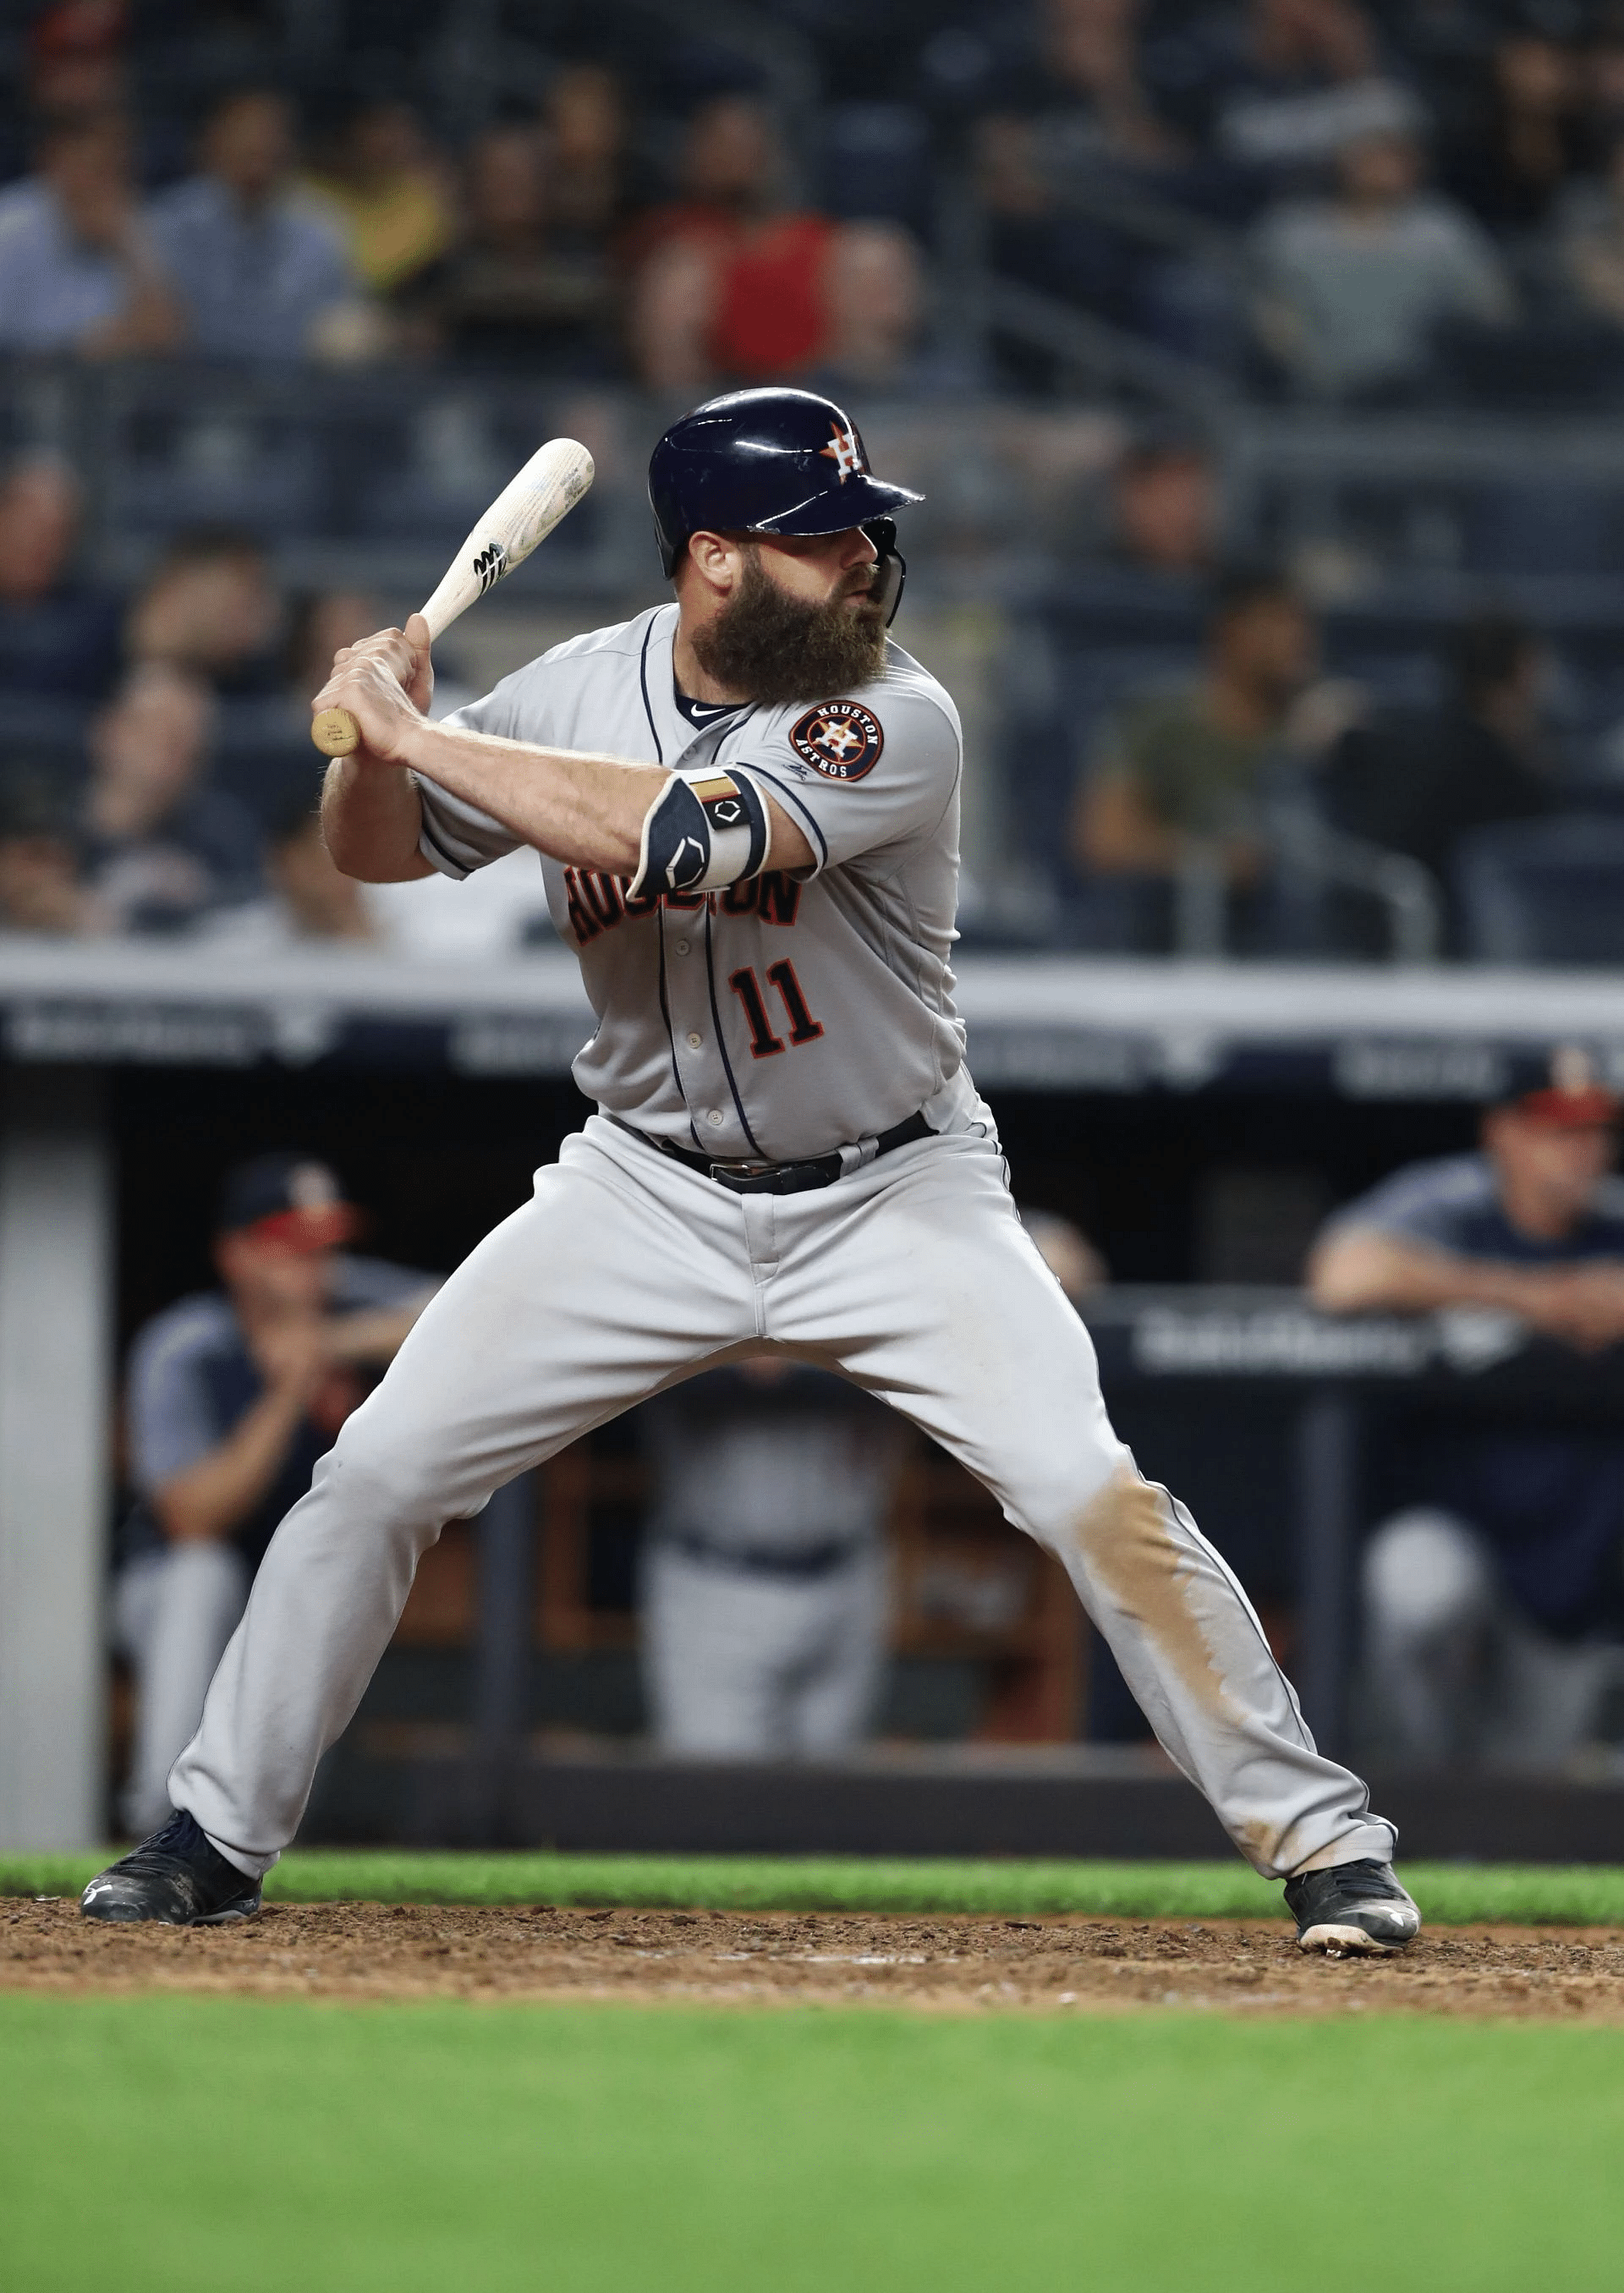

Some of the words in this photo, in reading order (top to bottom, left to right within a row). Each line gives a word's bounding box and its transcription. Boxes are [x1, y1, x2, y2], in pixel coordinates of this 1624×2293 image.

[817, 705, 878, 744] HOUSTON
[795, 738, 847, 777] ASTROS
[563, 864, 803, 946] HOUON
[728, 957, 825, 1059] 11
